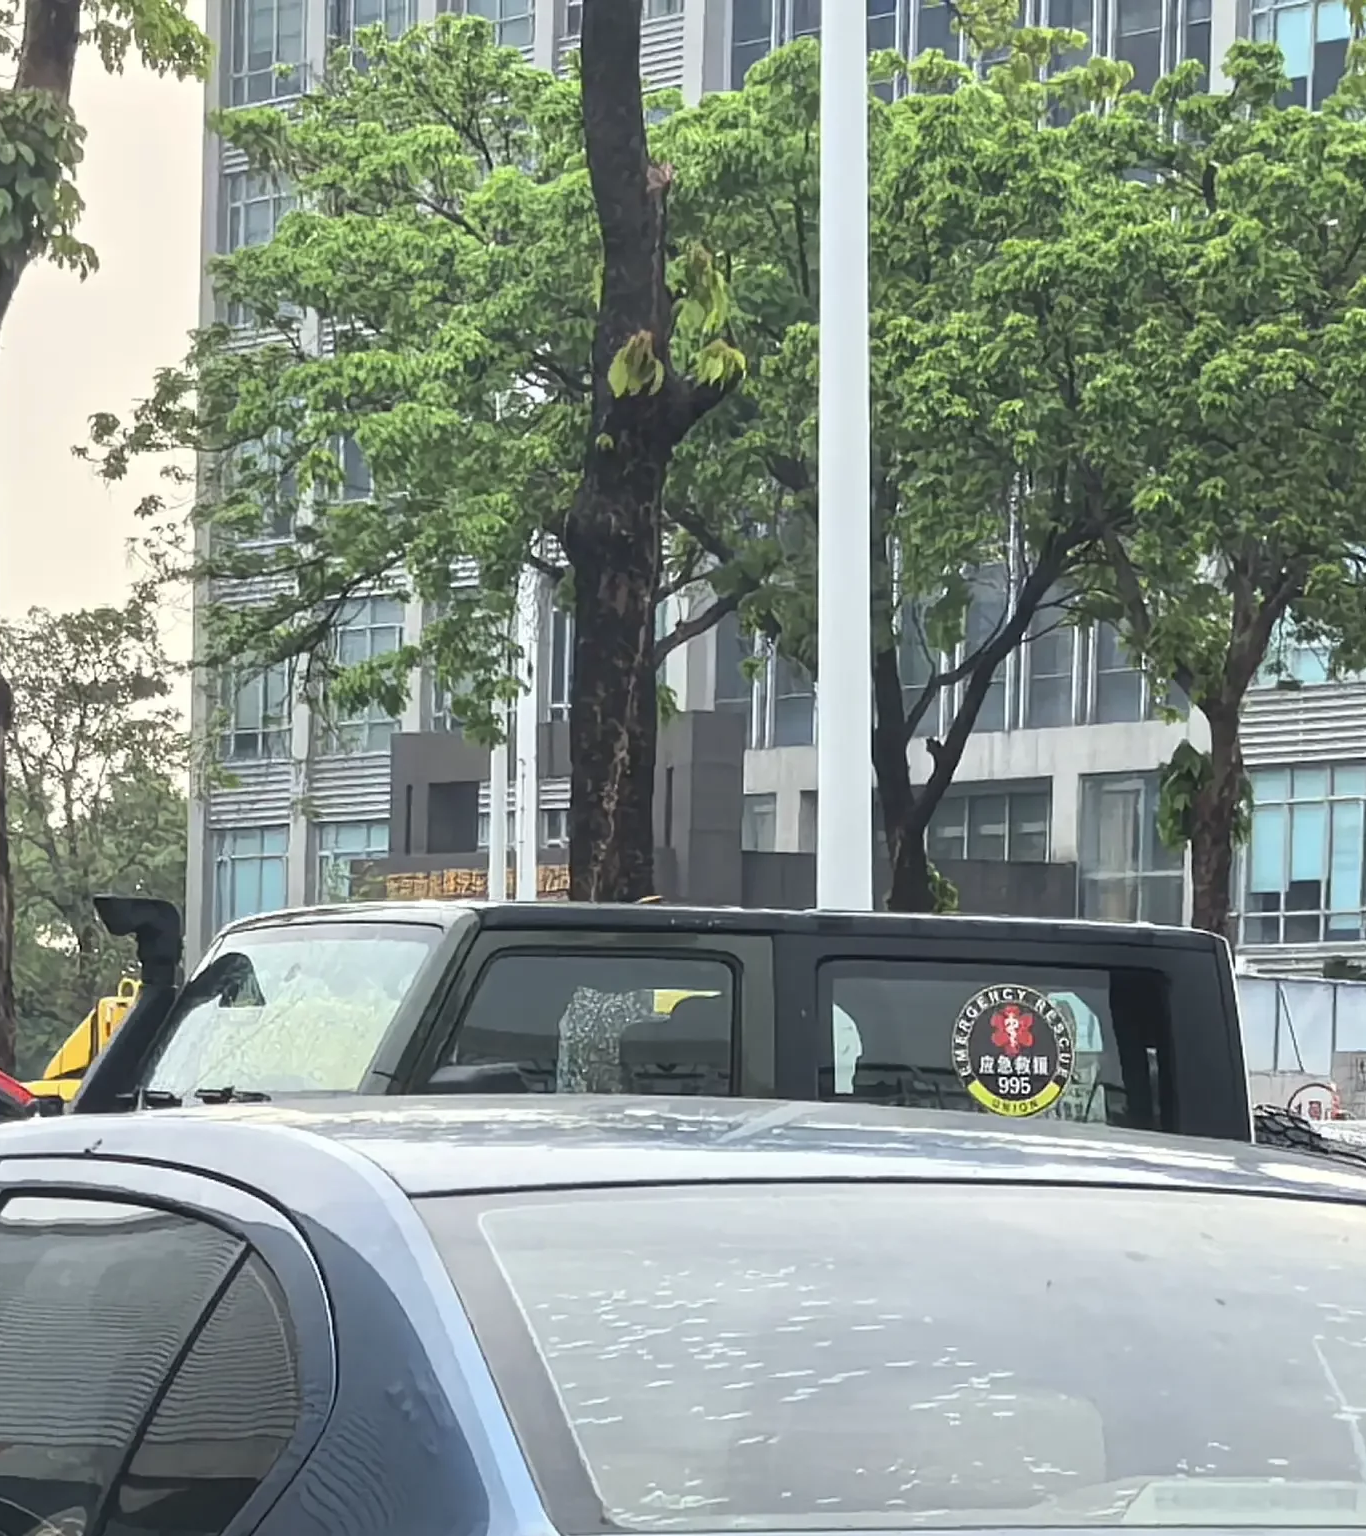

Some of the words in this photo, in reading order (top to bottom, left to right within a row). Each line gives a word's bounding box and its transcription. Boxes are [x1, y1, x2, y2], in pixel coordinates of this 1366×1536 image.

[955, 987, 1027, 1077] EMERGENCY
[1035, 1000, 1072, 1078] RESCUE
[998, 1076, 1031, 1094] 995
